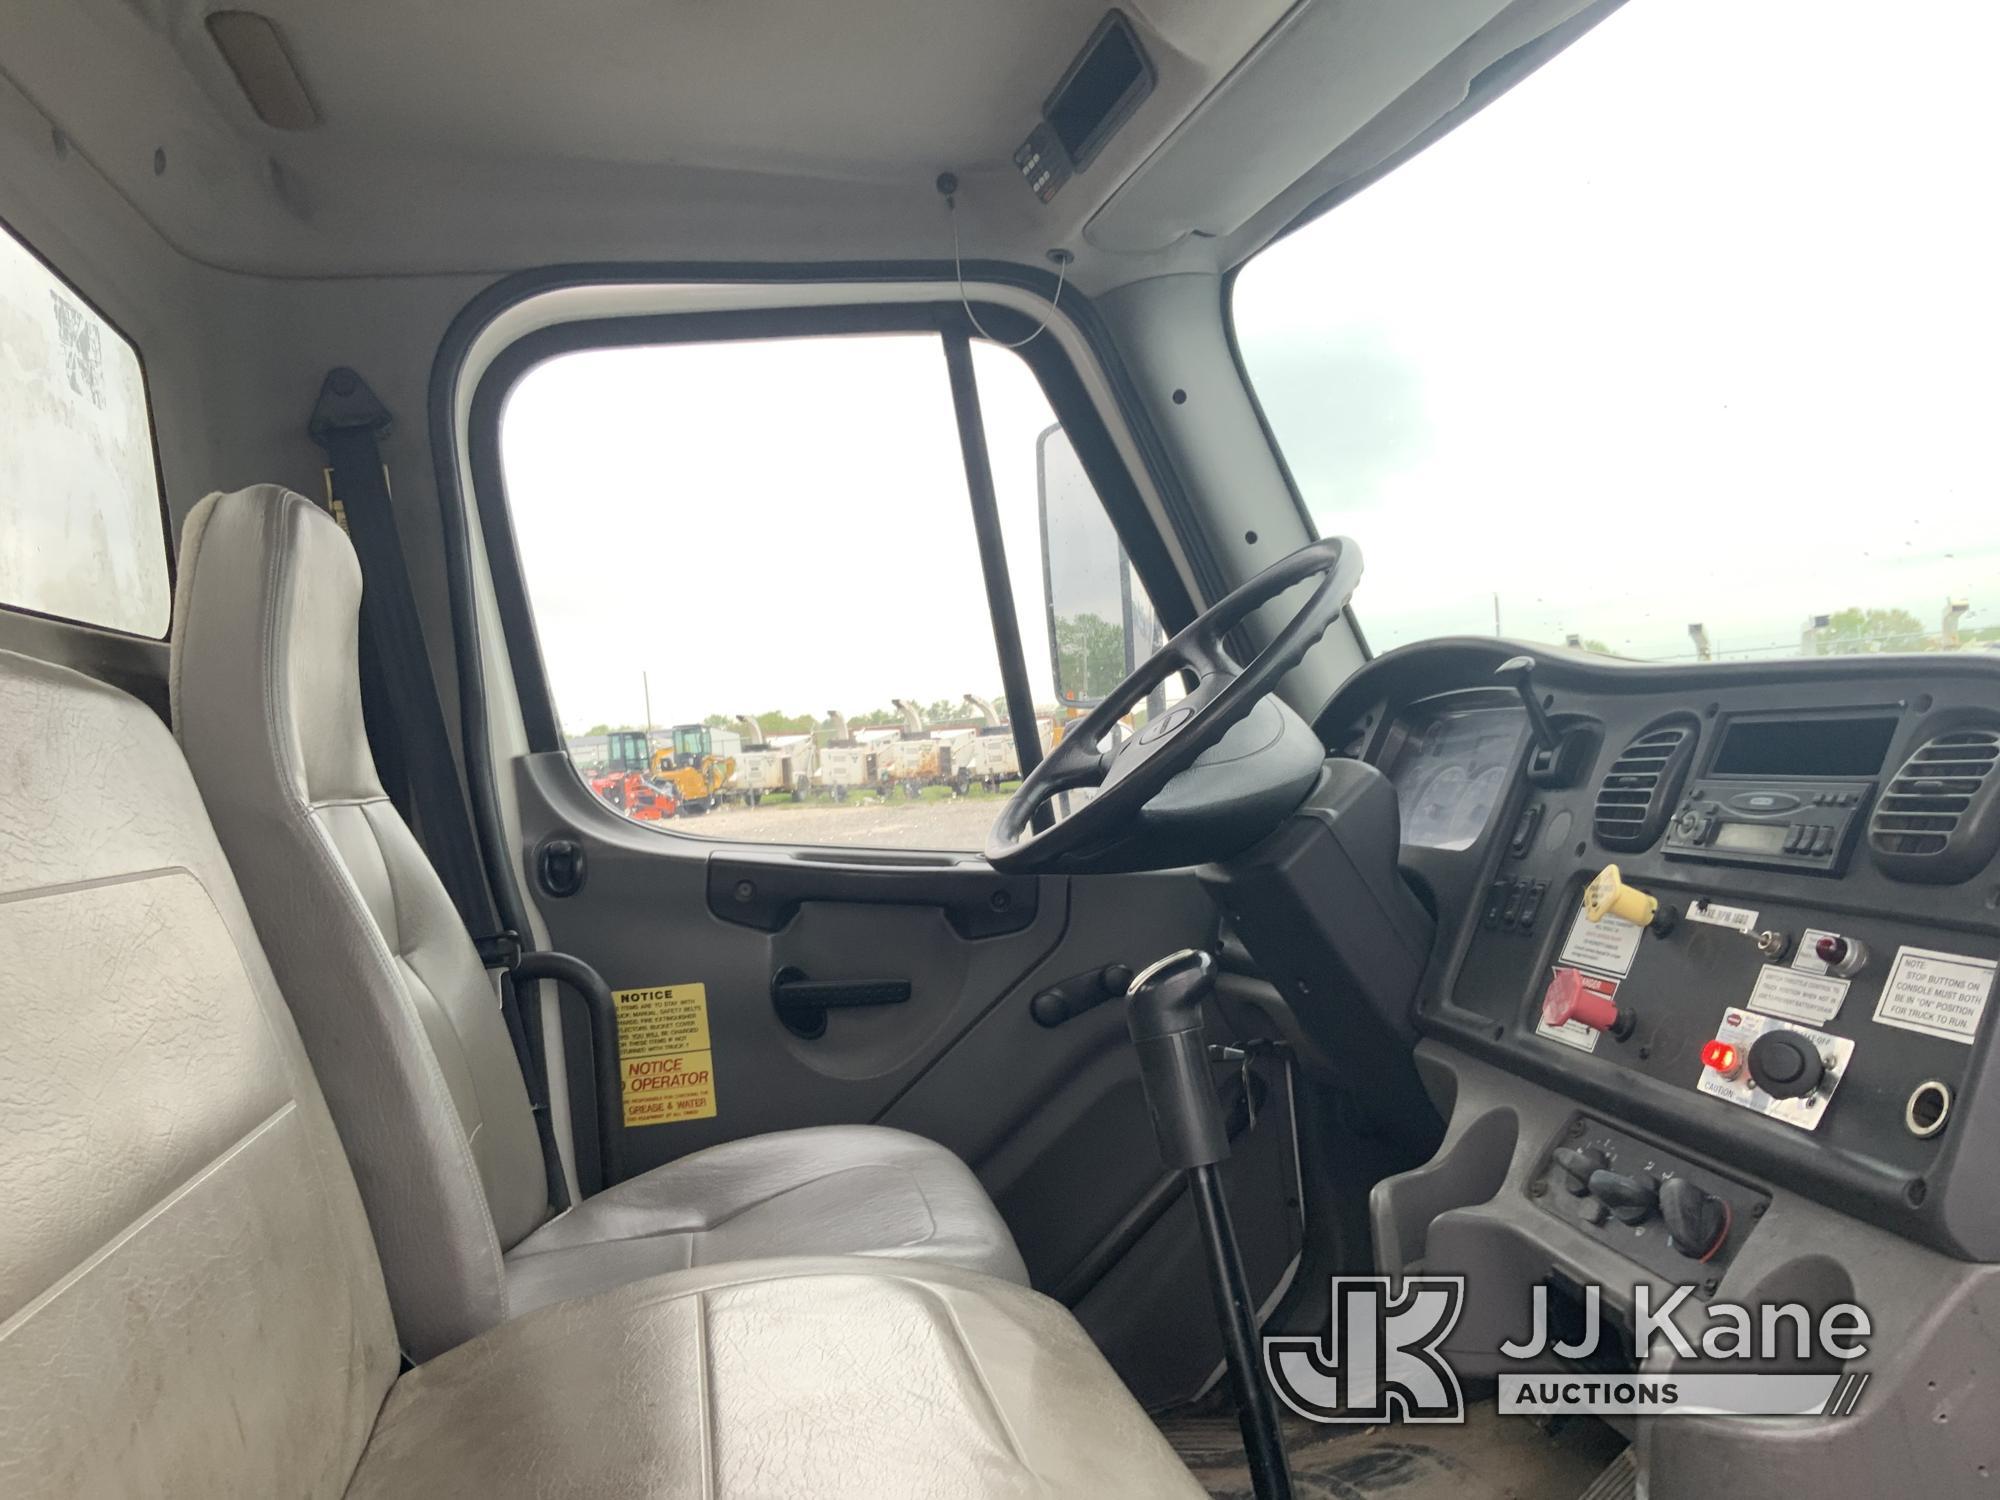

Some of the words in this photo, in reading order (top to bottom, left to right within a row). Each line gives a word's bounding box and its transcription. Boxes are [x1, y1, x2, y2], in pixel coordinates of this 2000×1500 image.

[1906, 972, 1926, 981] STOP
[1928, 975, 1966, 988] BUTTONS
[1967, 982, 1980, 991] ON
[621, 990, 672, 1003] NOTICE
[1896, 982, 1932, 995] CONSOLE
[1935, 989, 1957, 1000] MUST
[1958, 994, 1982, 1006] BOTH
[1891, 1005, 1907, 1015] FOR
[1908, 1008, 1934, 1019] TRUCK
[1936, 1015, 1948, 1024] TO
[1936, 1001, 1975, 1016] POSITION
[628, 1058, 683, 1077] NOTICE
[631, 1070, 709, 1092] OPERATOR
[1704, 1082, 1734, 1098] CAUTION
[628, 1102, 664, 1115] GREASE
[667, 1101, 673, 1110] &
[676, 1097, 707, 1109] WATER
